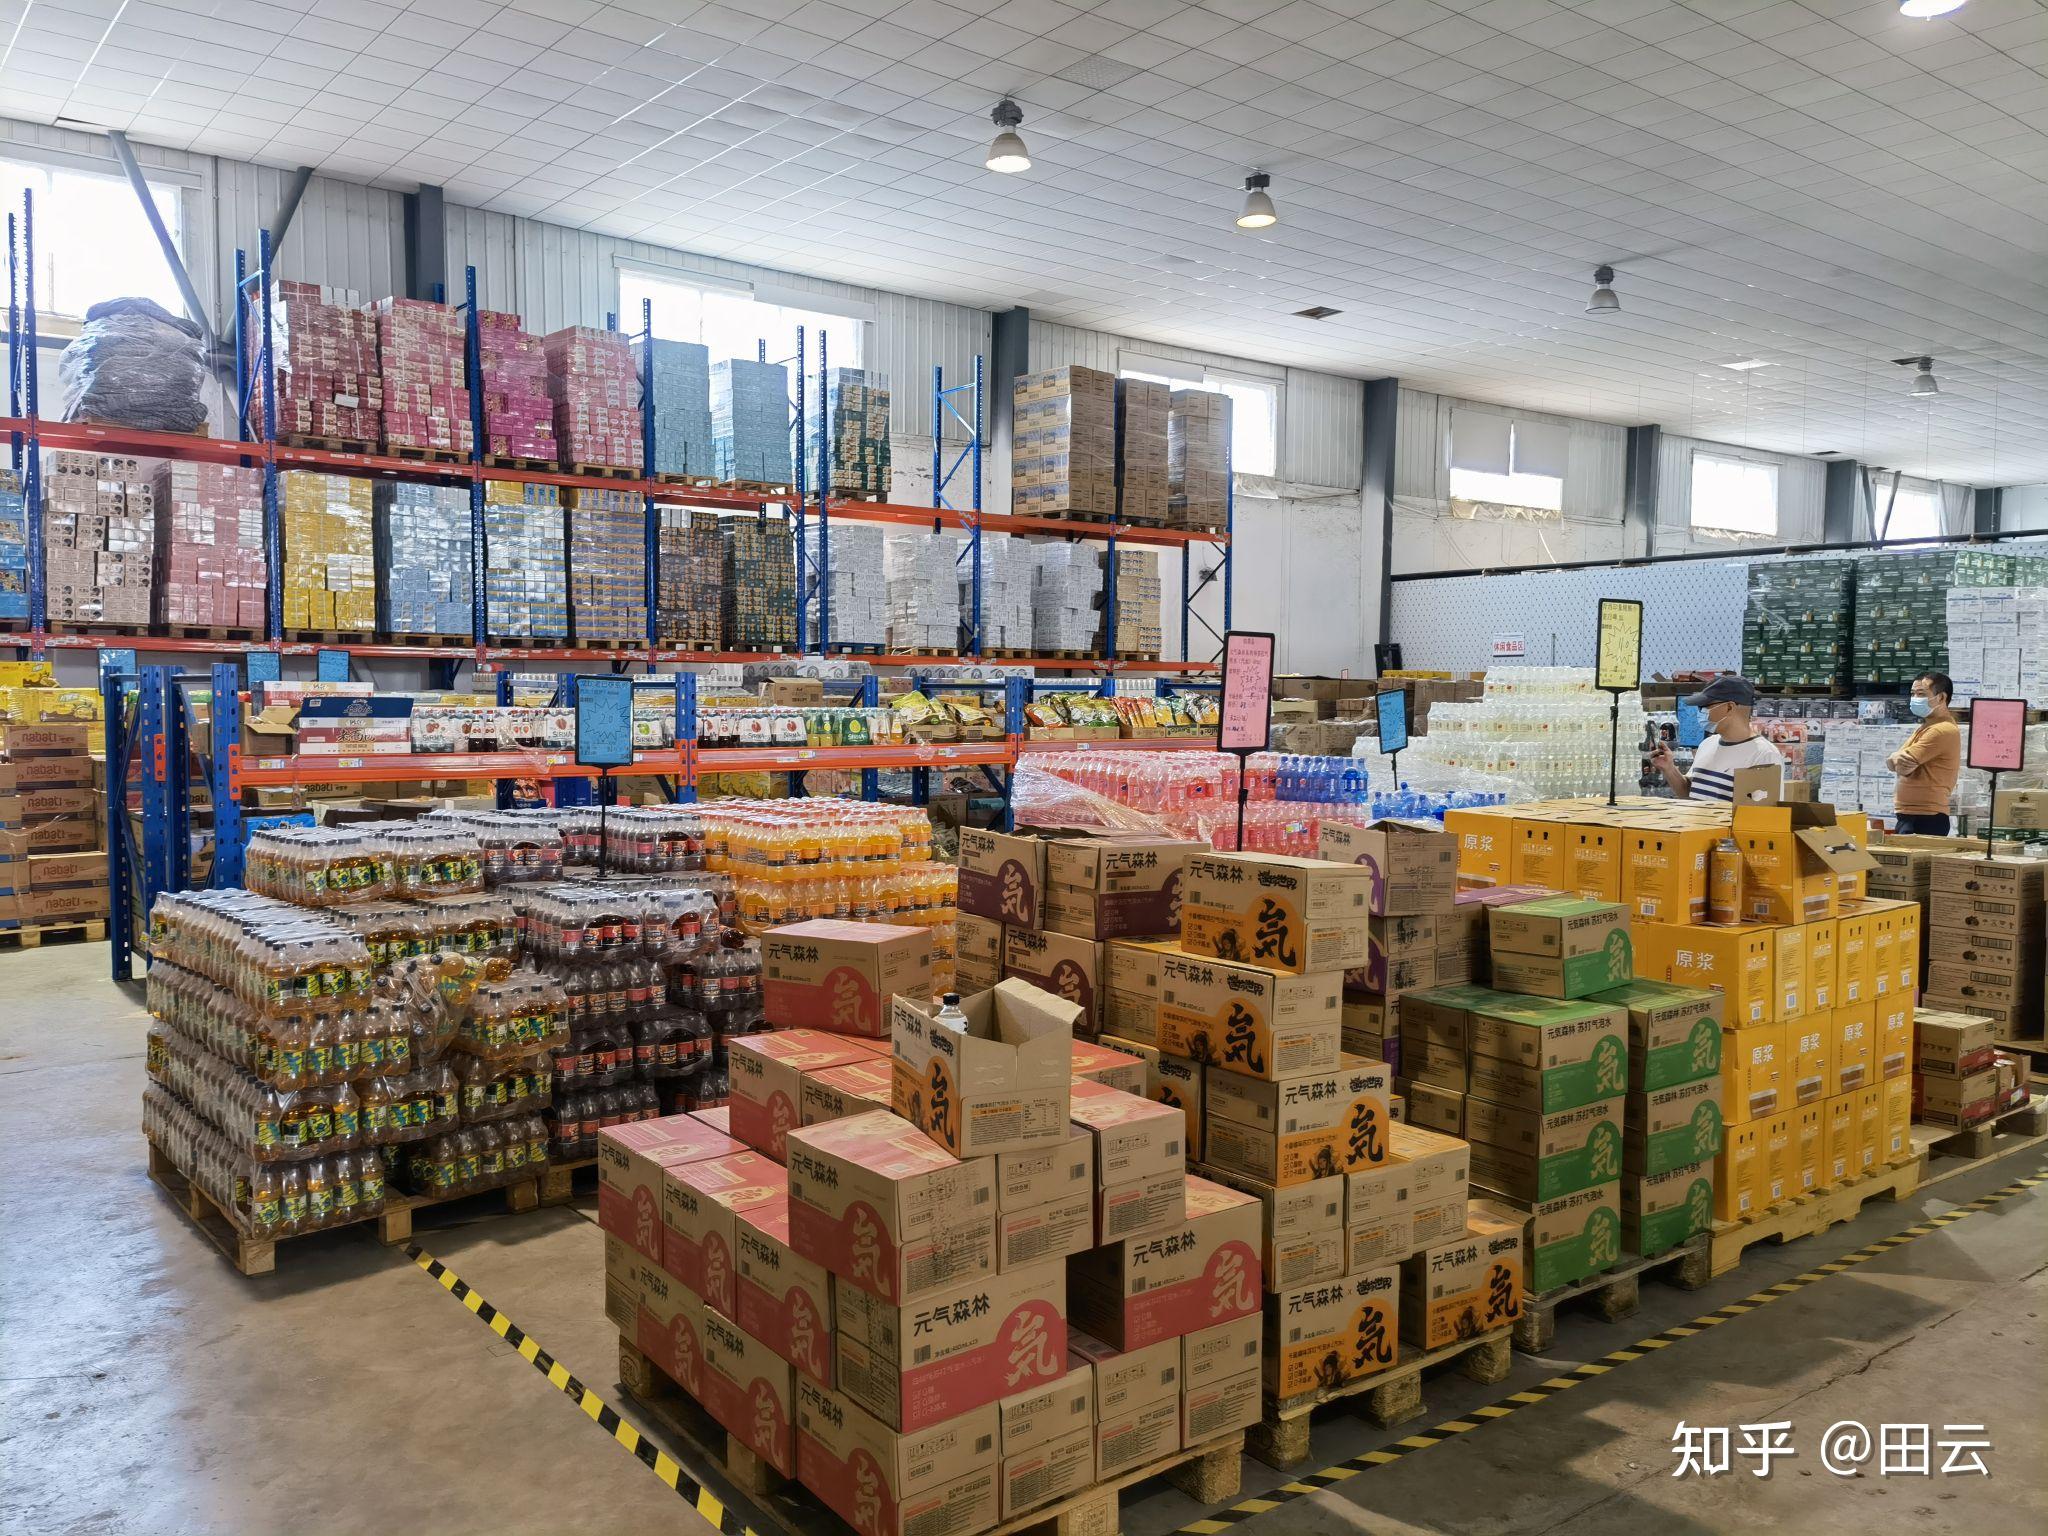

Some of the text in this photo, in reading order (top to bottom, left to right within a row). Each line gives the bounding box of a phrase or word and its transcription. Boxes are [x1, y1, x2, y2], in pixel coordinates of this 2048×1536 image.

[22, 732, 57, 743] nabati
[27, 764, 61, 775] nabati
[28, 796, 62, 807] nabati
[31, 828, 65, 840] nabati
[961, 832, 995, 853] 元气森林
[1464, 834, 1493, 852] 原浆
[43, 864, 78, 876] nabati
[1106, 851, 1158, 870] 元气森林
[1190, 860, 1244, 884] 元气森林
[45, 897, 80, 909] nabati
[1008, 930, 1048, 952] 元气森林
[768, 943, 820, 963] 元气森林
[1676, 949, 1714, 971] 原浆
[1164, 960, 1214, 987] 元气森林
[894, 1004, 922, 1041] 元气森林
[1844, 1022, 1864, 1042] 原浆
[1887, 1011, 1905, 1031] 原浆
[1752, 1044, 1775, 1065] 原浆
[1800, 1032, 1821, 1054] 原浆
[731, 1052, 764, 1079] 元气森林
[805, 1085, 844, 1116] 元气森林
[1285, 1080, 1338, 1106] 元气森林
[601, 1143, 630, 1173] 元气森林
[791, 1151, 839, 1190] 元气森林
[666, 1183, 699, 1217] 元气森林
[741, 1232, 781, 1272] 元气森林
[1133, 1230, 1196, 1267] 元气森林
[1432, 1245, 1478, 1273] 元气森林
[1289, 1284, 1343, 1315] 元气森林
[914, 1293, 990, 1337] 元气森林
[705, 1317, 745, 1359] 元气森林
[801, 1381, 844, 1430] 元气森林
